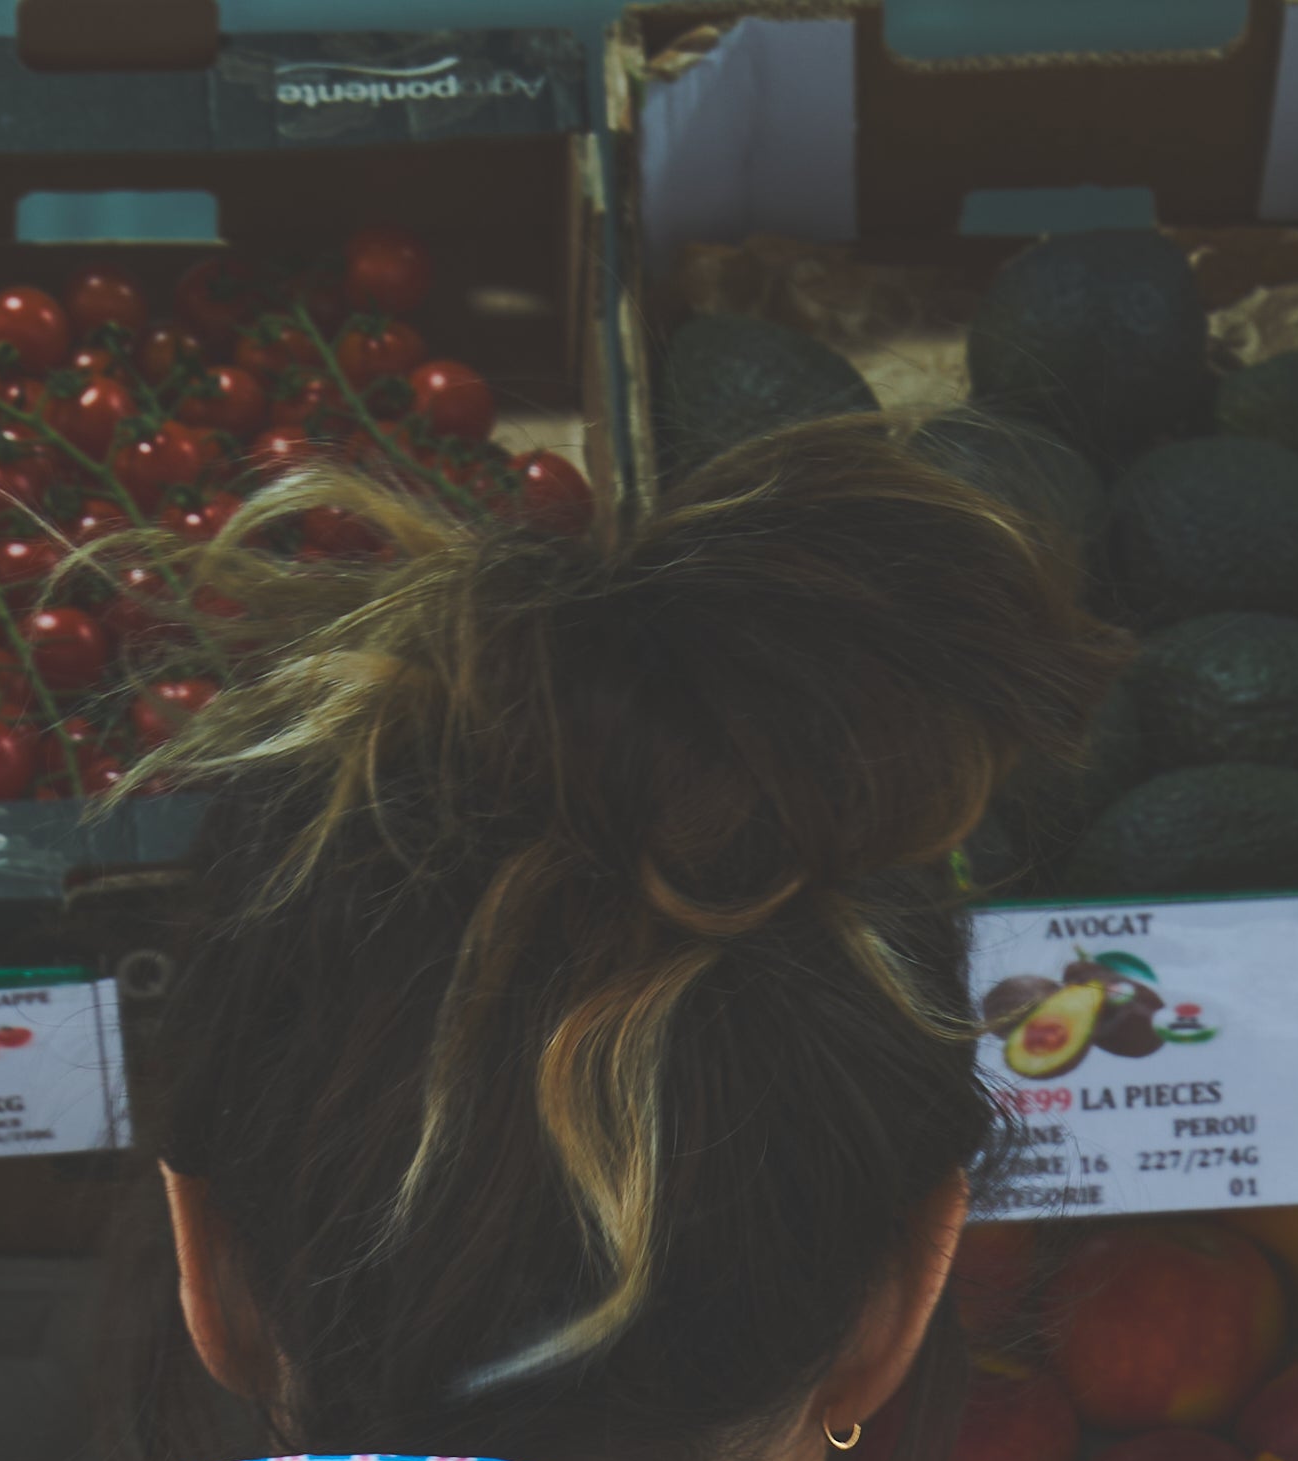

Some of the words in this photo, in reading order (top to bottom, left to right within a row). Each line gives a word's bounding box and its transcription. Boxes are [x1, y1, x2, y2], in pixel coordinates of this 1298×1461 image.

[1046, 913, 1153, 940] AVOCAT
[1080, 1086, 1116, 1111] LA
[1125, 1081, 1222, 1109] PIECES
[1173, 1115, 1256, 1138] PEROU
[1138, 1147, 1259, 1174] 227/274G
